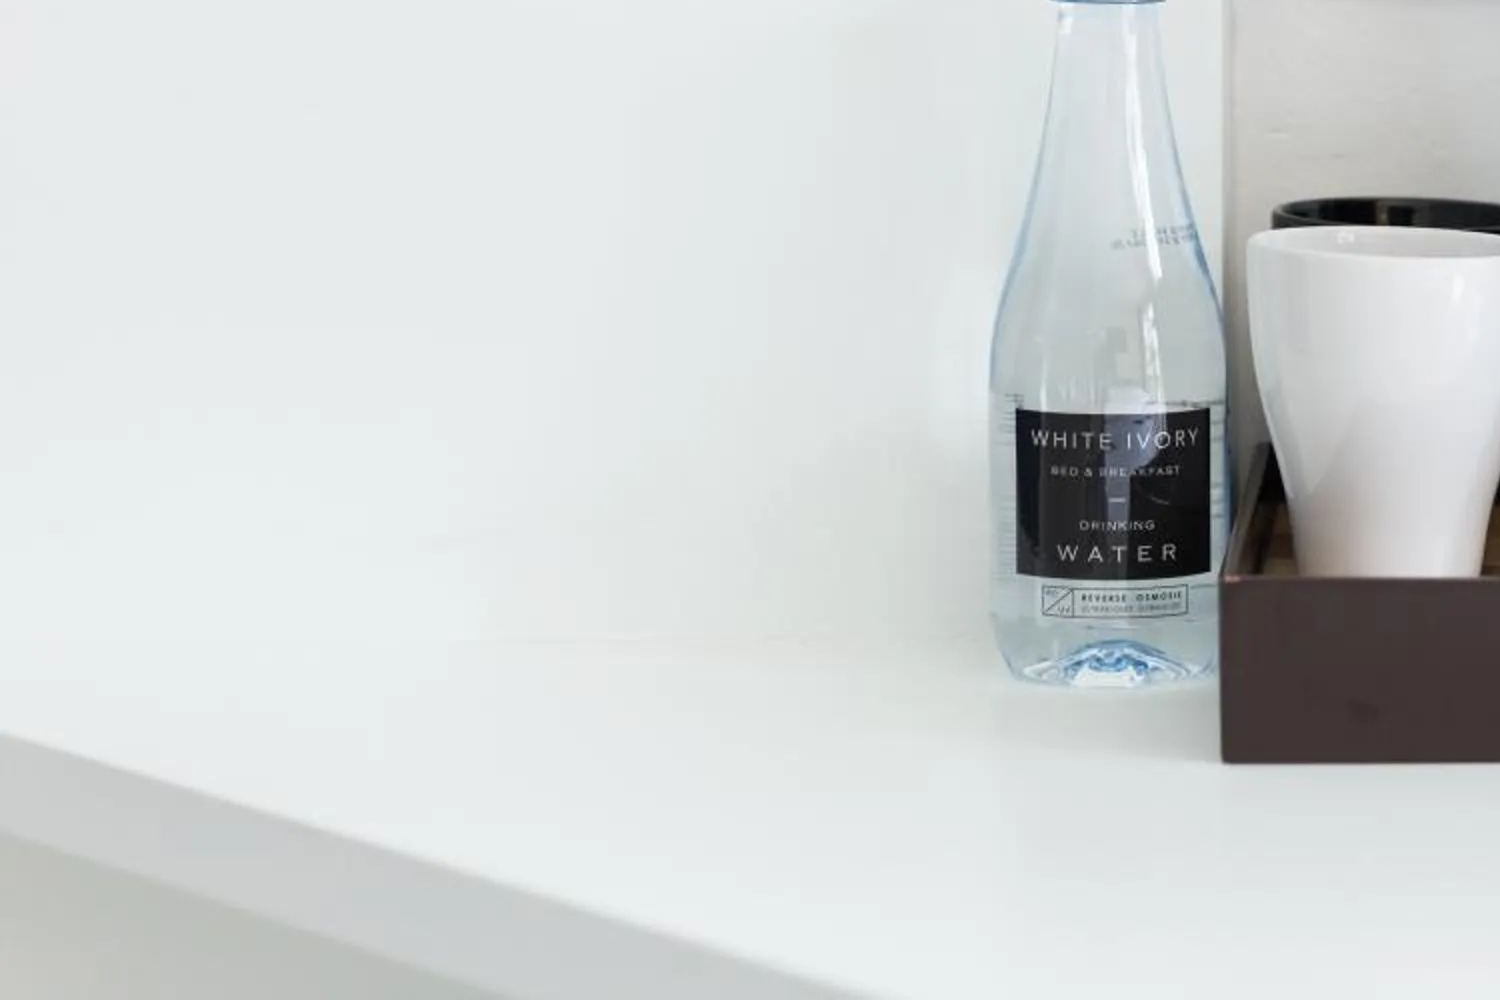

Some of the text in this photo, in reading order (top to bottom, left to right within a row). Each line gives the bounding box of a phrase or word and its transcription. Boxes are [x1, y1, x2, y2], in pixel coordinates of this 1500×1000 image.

[1031, 427, 1199, 450] WHITE IVORY
[1050, 464, 1079, 478] BED
[1079, 519, 1156, 532] DRINKING
[1057, 543, 1177, 563] WATER
